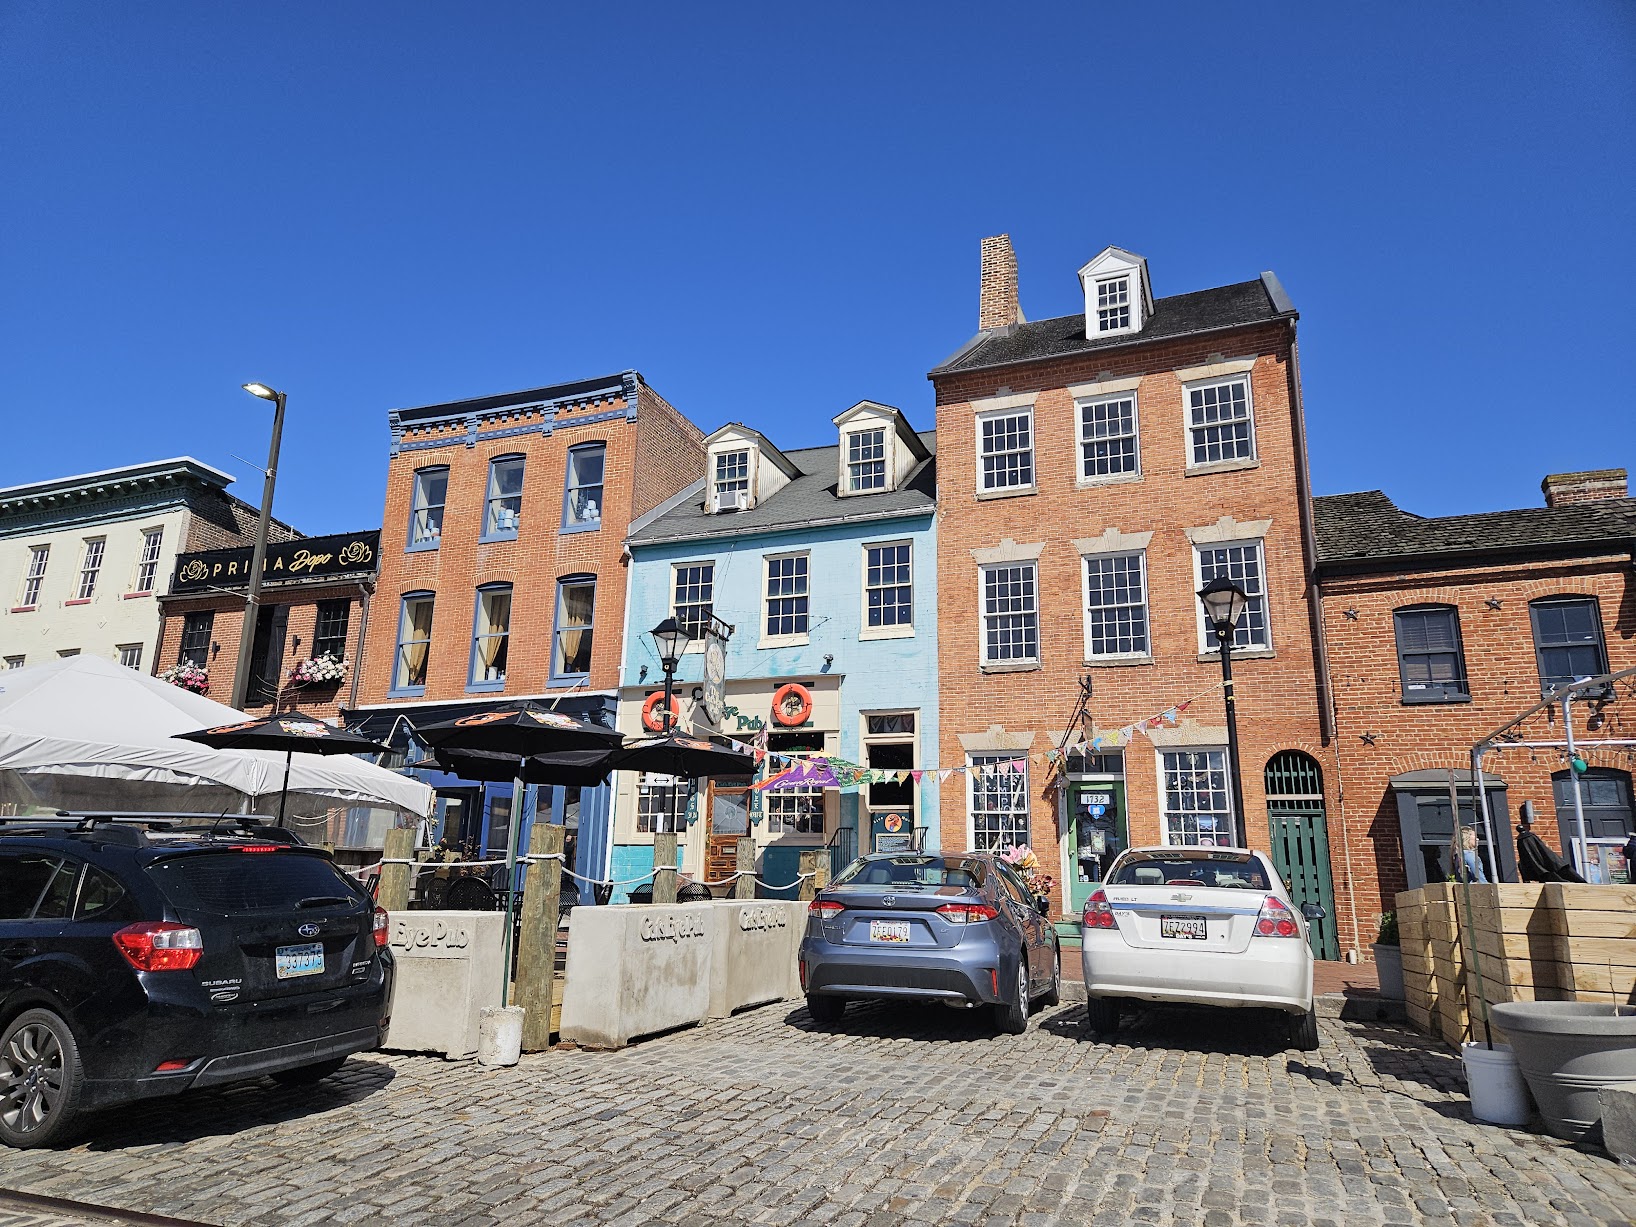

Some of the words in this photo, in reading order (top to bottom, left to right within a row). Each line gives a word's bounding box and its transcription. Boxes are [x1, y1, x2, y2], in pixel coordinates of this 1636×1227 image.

[213, 557, 284, 577] PRIA
[289, 550, 333, 573] Dopo
[736, 715, 763, 731] Pub
[1086, 795, 1105, 803] 1732
[392, 919, 430, 951] Eye
[430, 919, 470, 949] Pub
[201, 978, 243, 987] SUBARU
